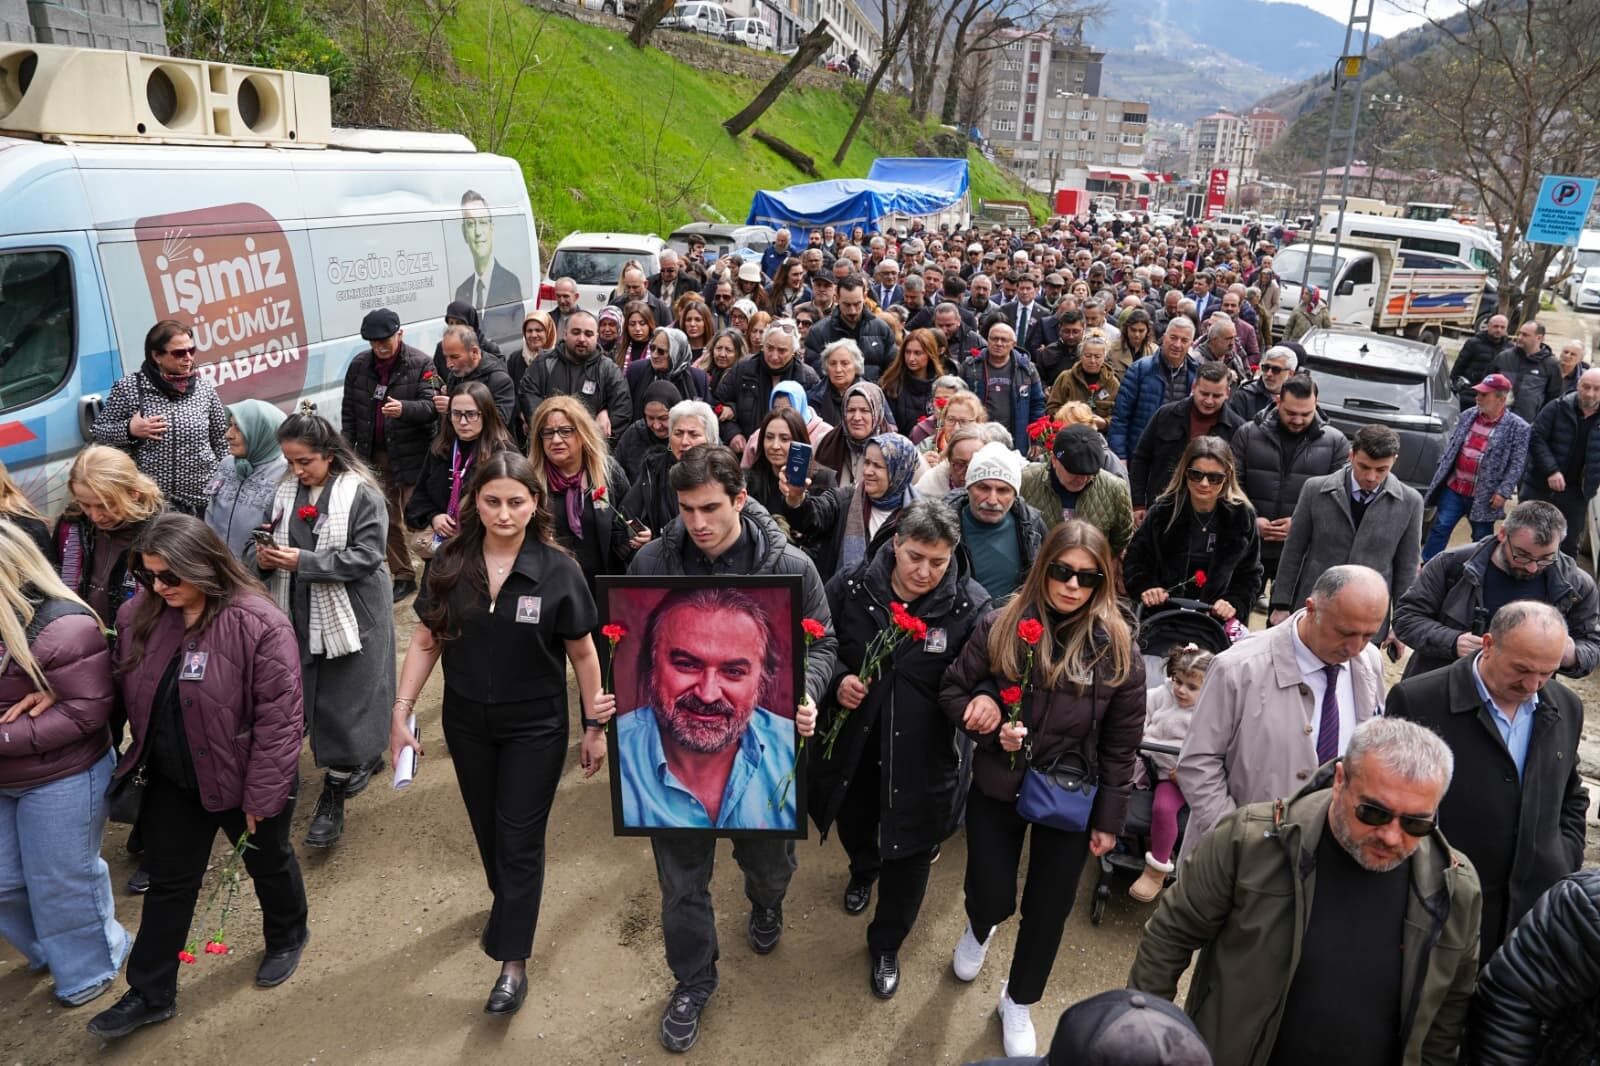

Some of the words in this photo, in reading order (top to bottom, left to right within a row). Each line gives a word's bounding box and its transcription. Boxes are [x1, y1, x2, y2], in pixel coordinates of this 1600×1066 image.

[327, 253, 393, 285] ÖZGÜR
[395, 250, 439, 275] ÖZEL
[193, 296, 294, 351] ÜCÜMÜZ
[197, 332, 300, 387] RABZON
